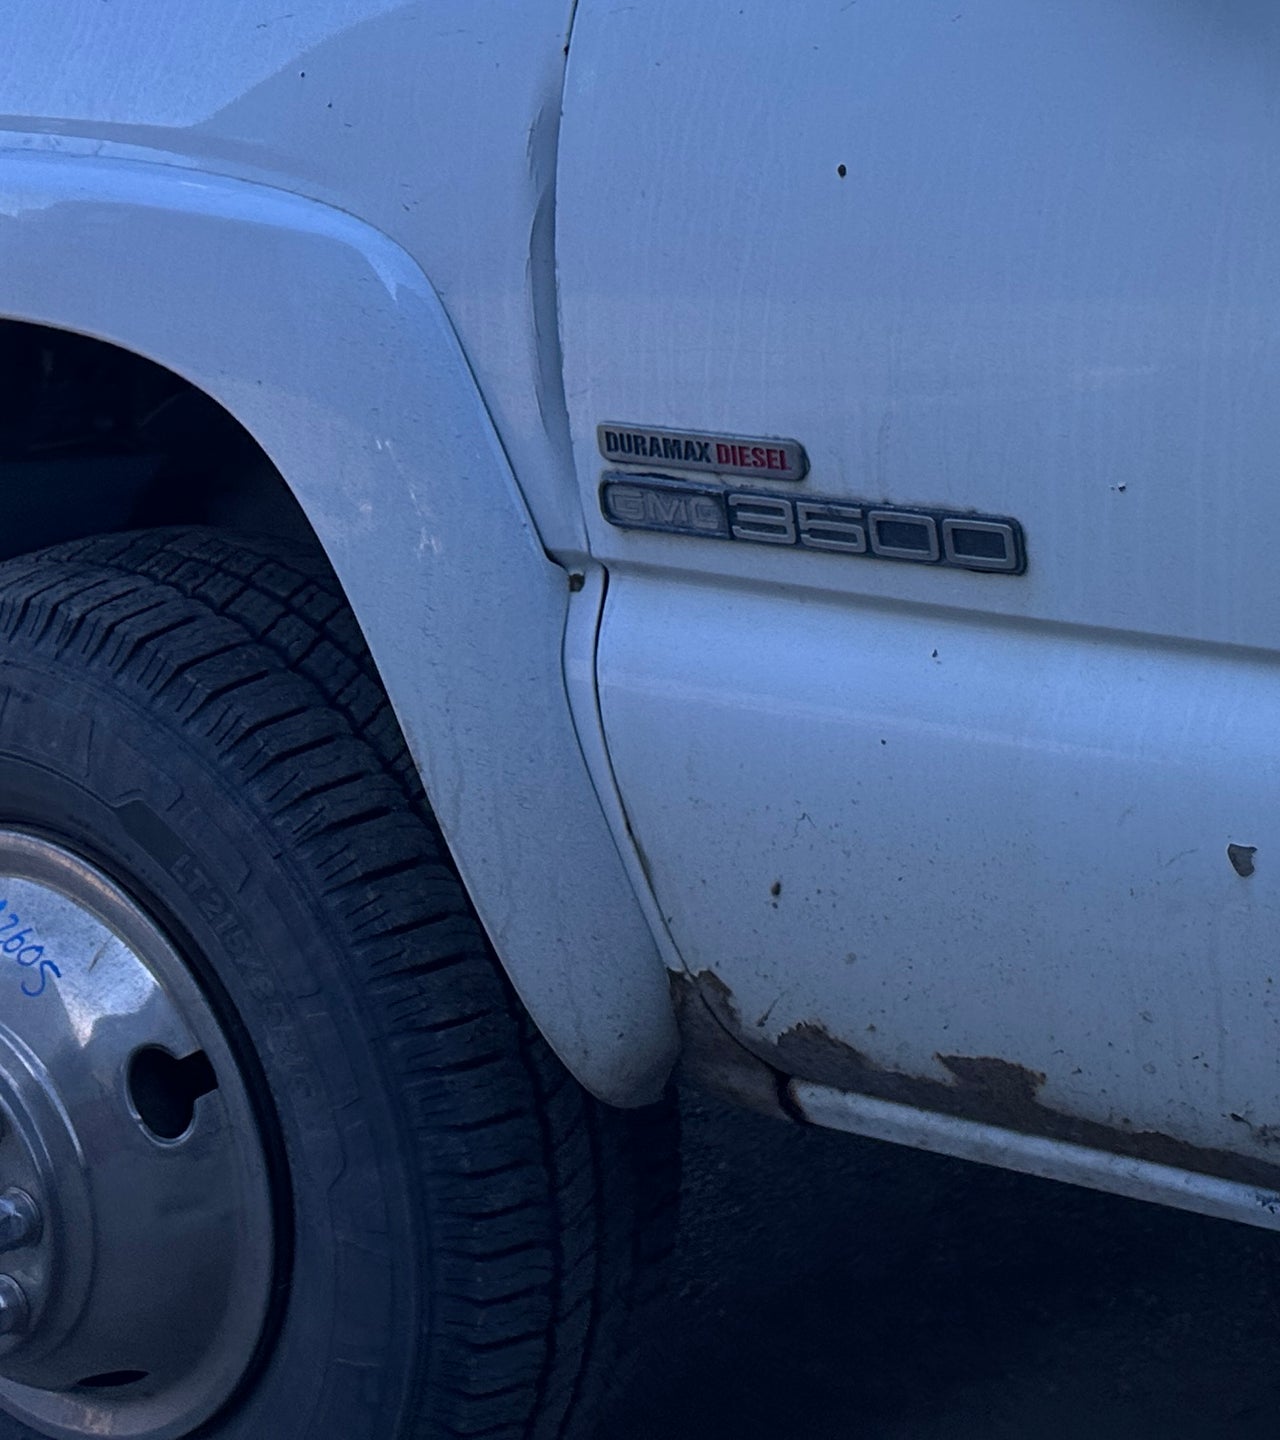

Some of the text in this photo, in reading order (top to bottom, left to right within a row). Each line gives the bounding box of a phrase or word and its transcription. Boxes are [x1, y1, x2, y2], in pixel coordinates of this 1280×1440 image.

[604, 431, 793, 471] DURAMAX DIESEL
[612, 490, 1015, 568] GMC 3500
